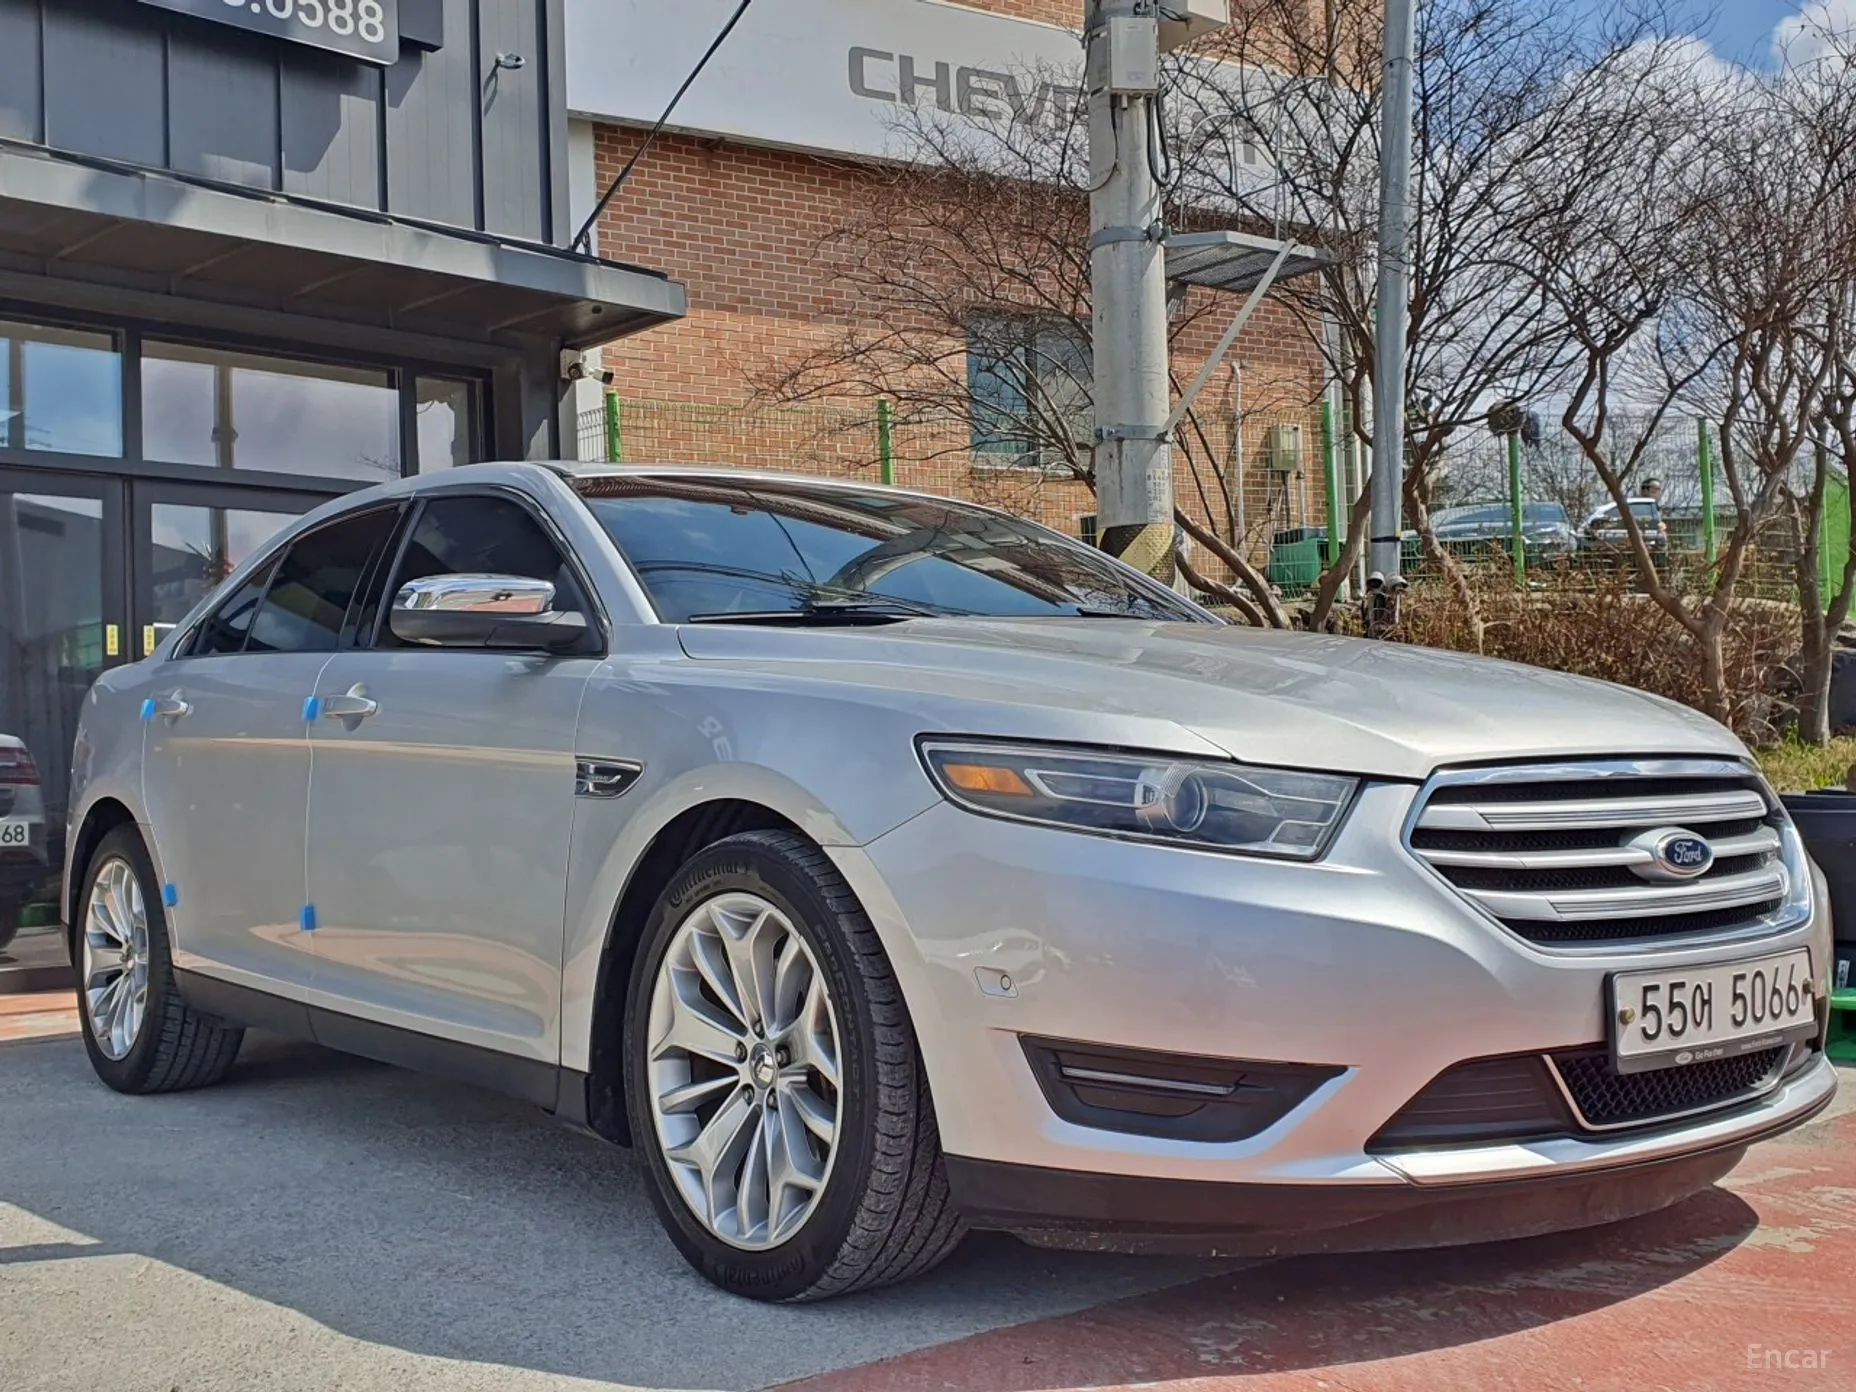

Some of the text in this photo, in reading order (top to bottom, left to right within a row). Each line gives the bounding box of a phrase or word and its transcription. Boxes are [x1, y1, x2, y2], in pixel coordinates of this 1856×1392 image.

[1, 824, 25, 843] 68
[1674, 841, 1702, 863] Ford
[1641, 981, 1713, 1041] 55어
[1731, 964, 1799, 1027] 5066
